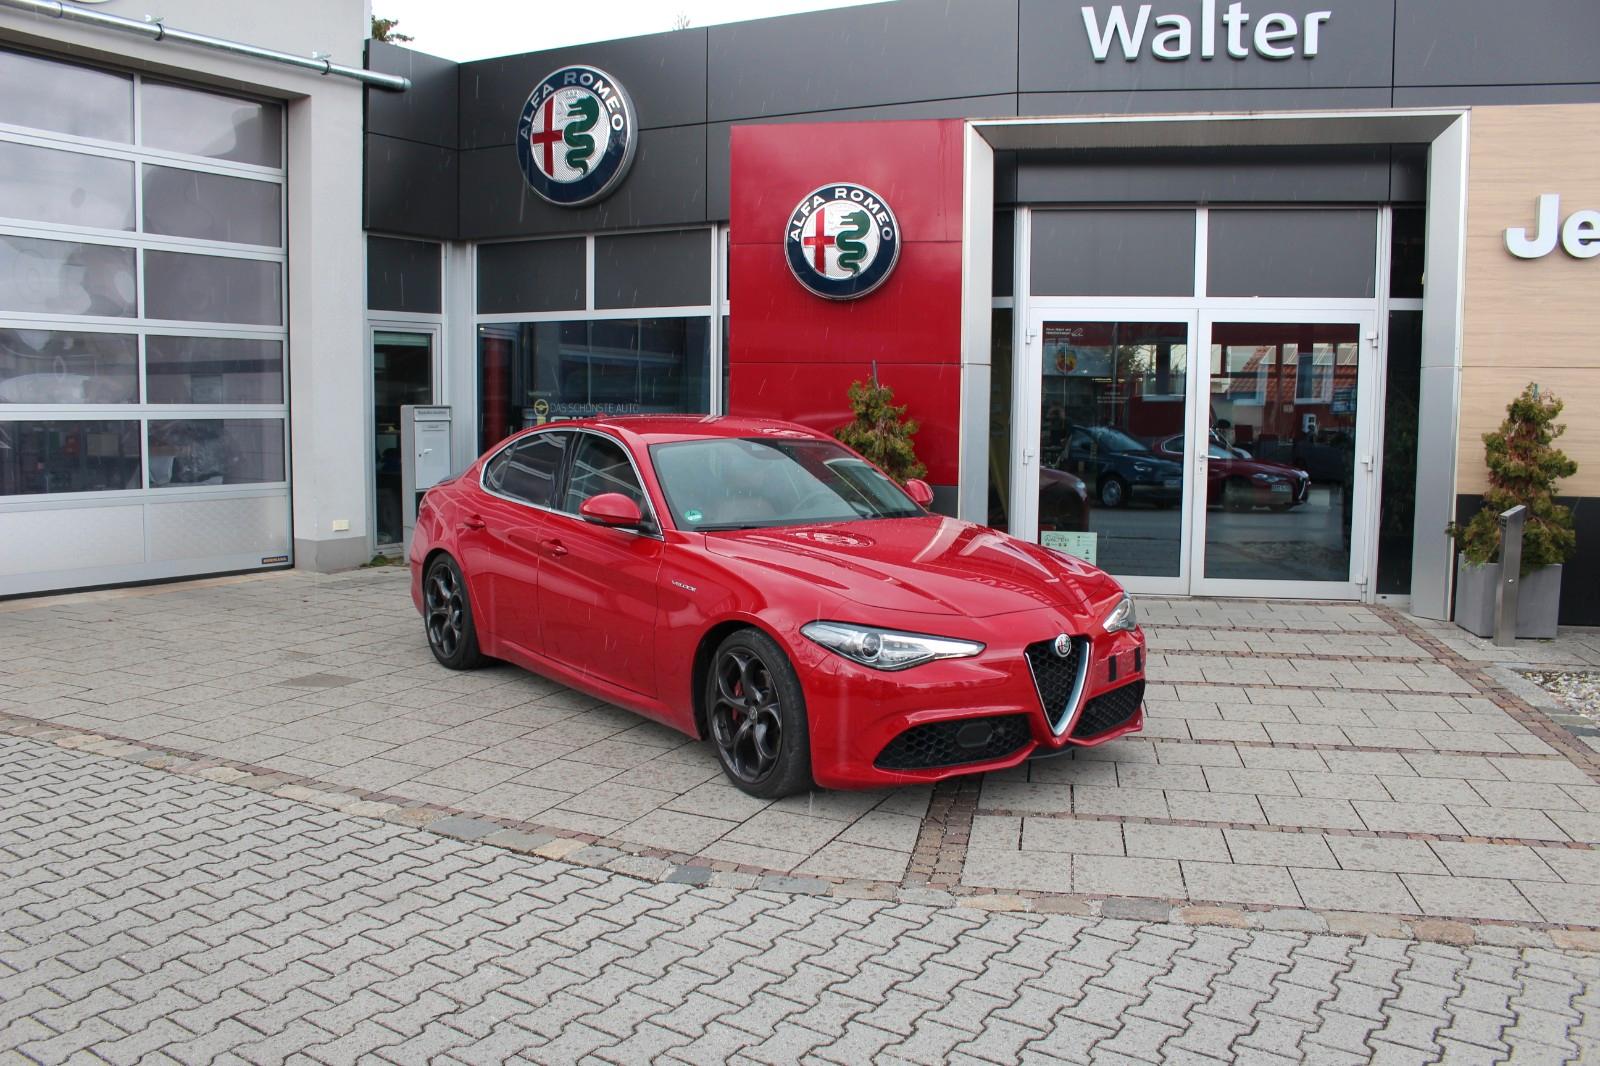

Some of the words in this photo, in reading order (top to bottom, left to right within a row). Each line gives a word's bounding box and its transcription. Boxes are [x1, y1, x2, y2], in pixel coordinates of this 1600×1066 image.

[1081, 0, 1331, 61] Walter
[520, 83, 554, 140] ALFA
[563, 71, 624, 131] ROMEO
[790, 194, 826, 242] ALFA
[834, 187, 893, 241] ROMEO
[1504, 193, 1600, 259] Je
[550, 403, 567, 414] DAS
[568, 402, 615, 414] SCHÖNSTE
[616, 403, 640, 414] AUTO
